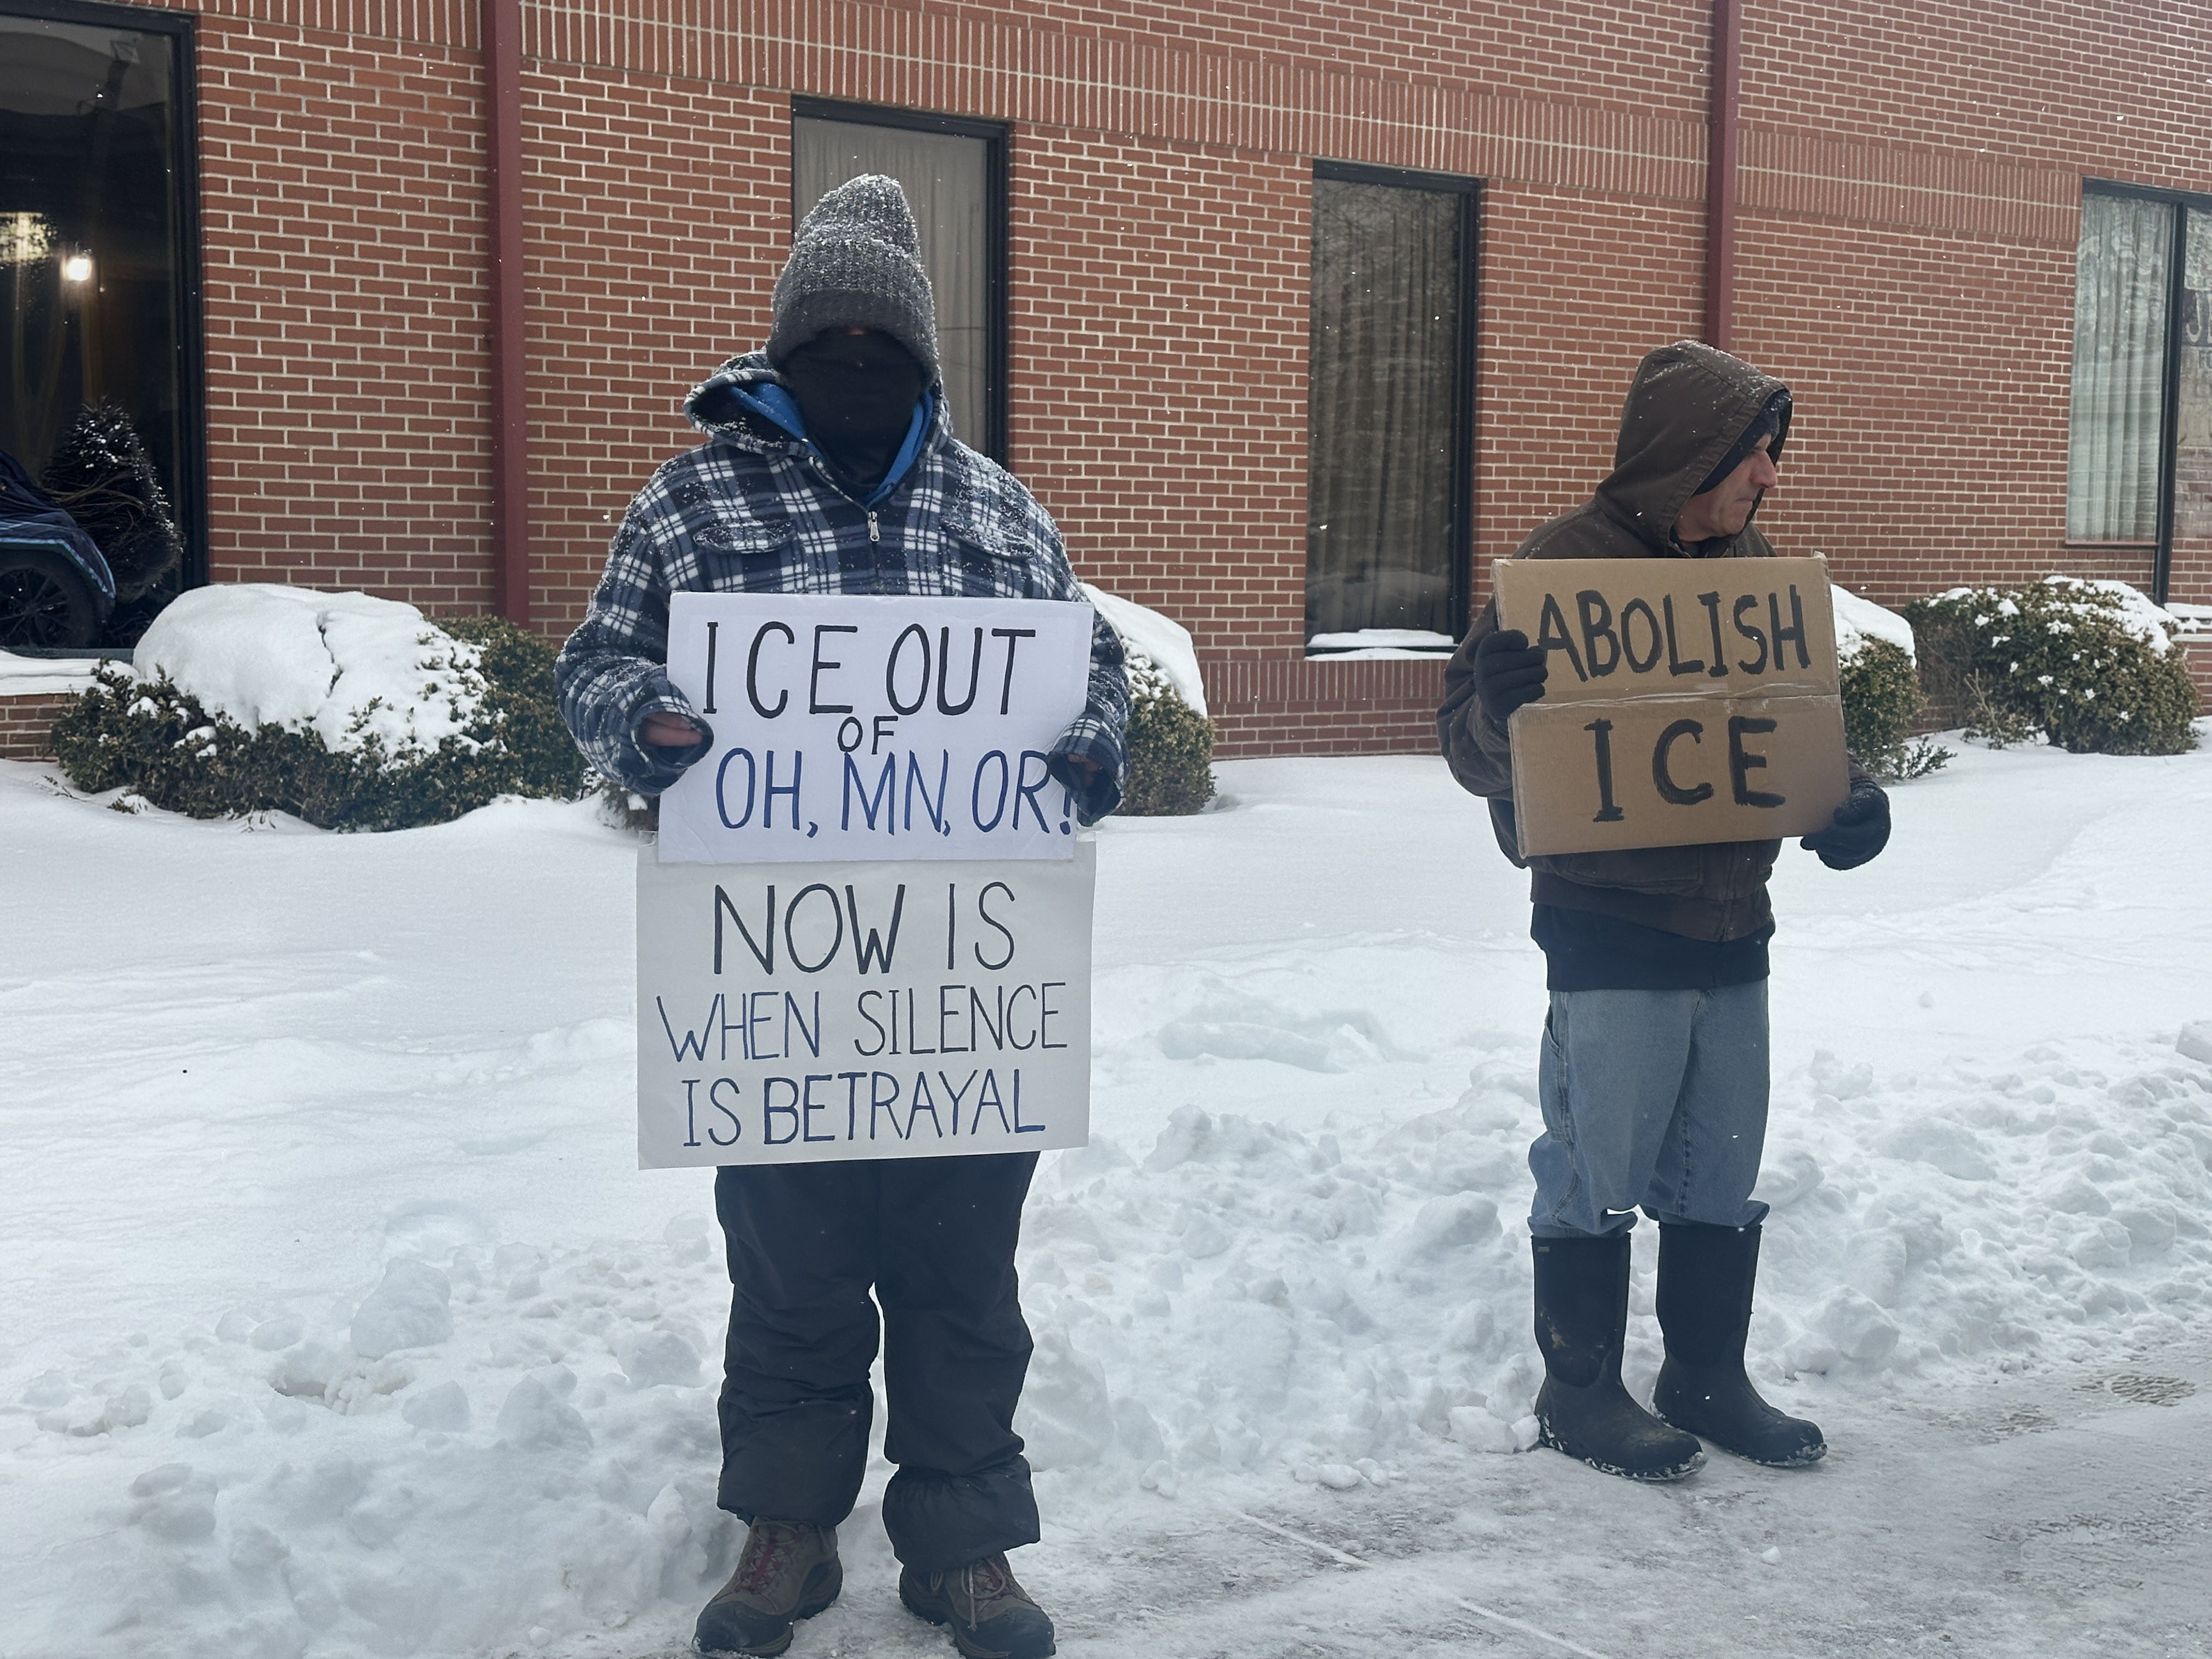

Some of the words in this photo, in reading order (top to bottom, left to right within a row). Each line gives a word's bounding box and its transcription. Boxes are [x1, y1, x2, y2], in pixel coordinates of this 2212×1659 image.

[703, 622, 858, 718] ICE
[886, 624, 1036, 715] OUT
[1538, 585, 1810, 682] ABOLISH
[838, 716, 898, 754] OF
[1584, 716, 1786, 822] ICE
[716, 748, 818, 838] OH,
[842, 750, 951, 835] MN,
[714, 884, 905, 975] NOW
[948, 882, 1015, 970] IS
[657, 991, 820, 1062] WHEN
[855, 983, 1068, 1056] SILENCE
[682, 1078, 741, 1146] IS
[764, 1069, 1046, 1145] BETRAYAL
